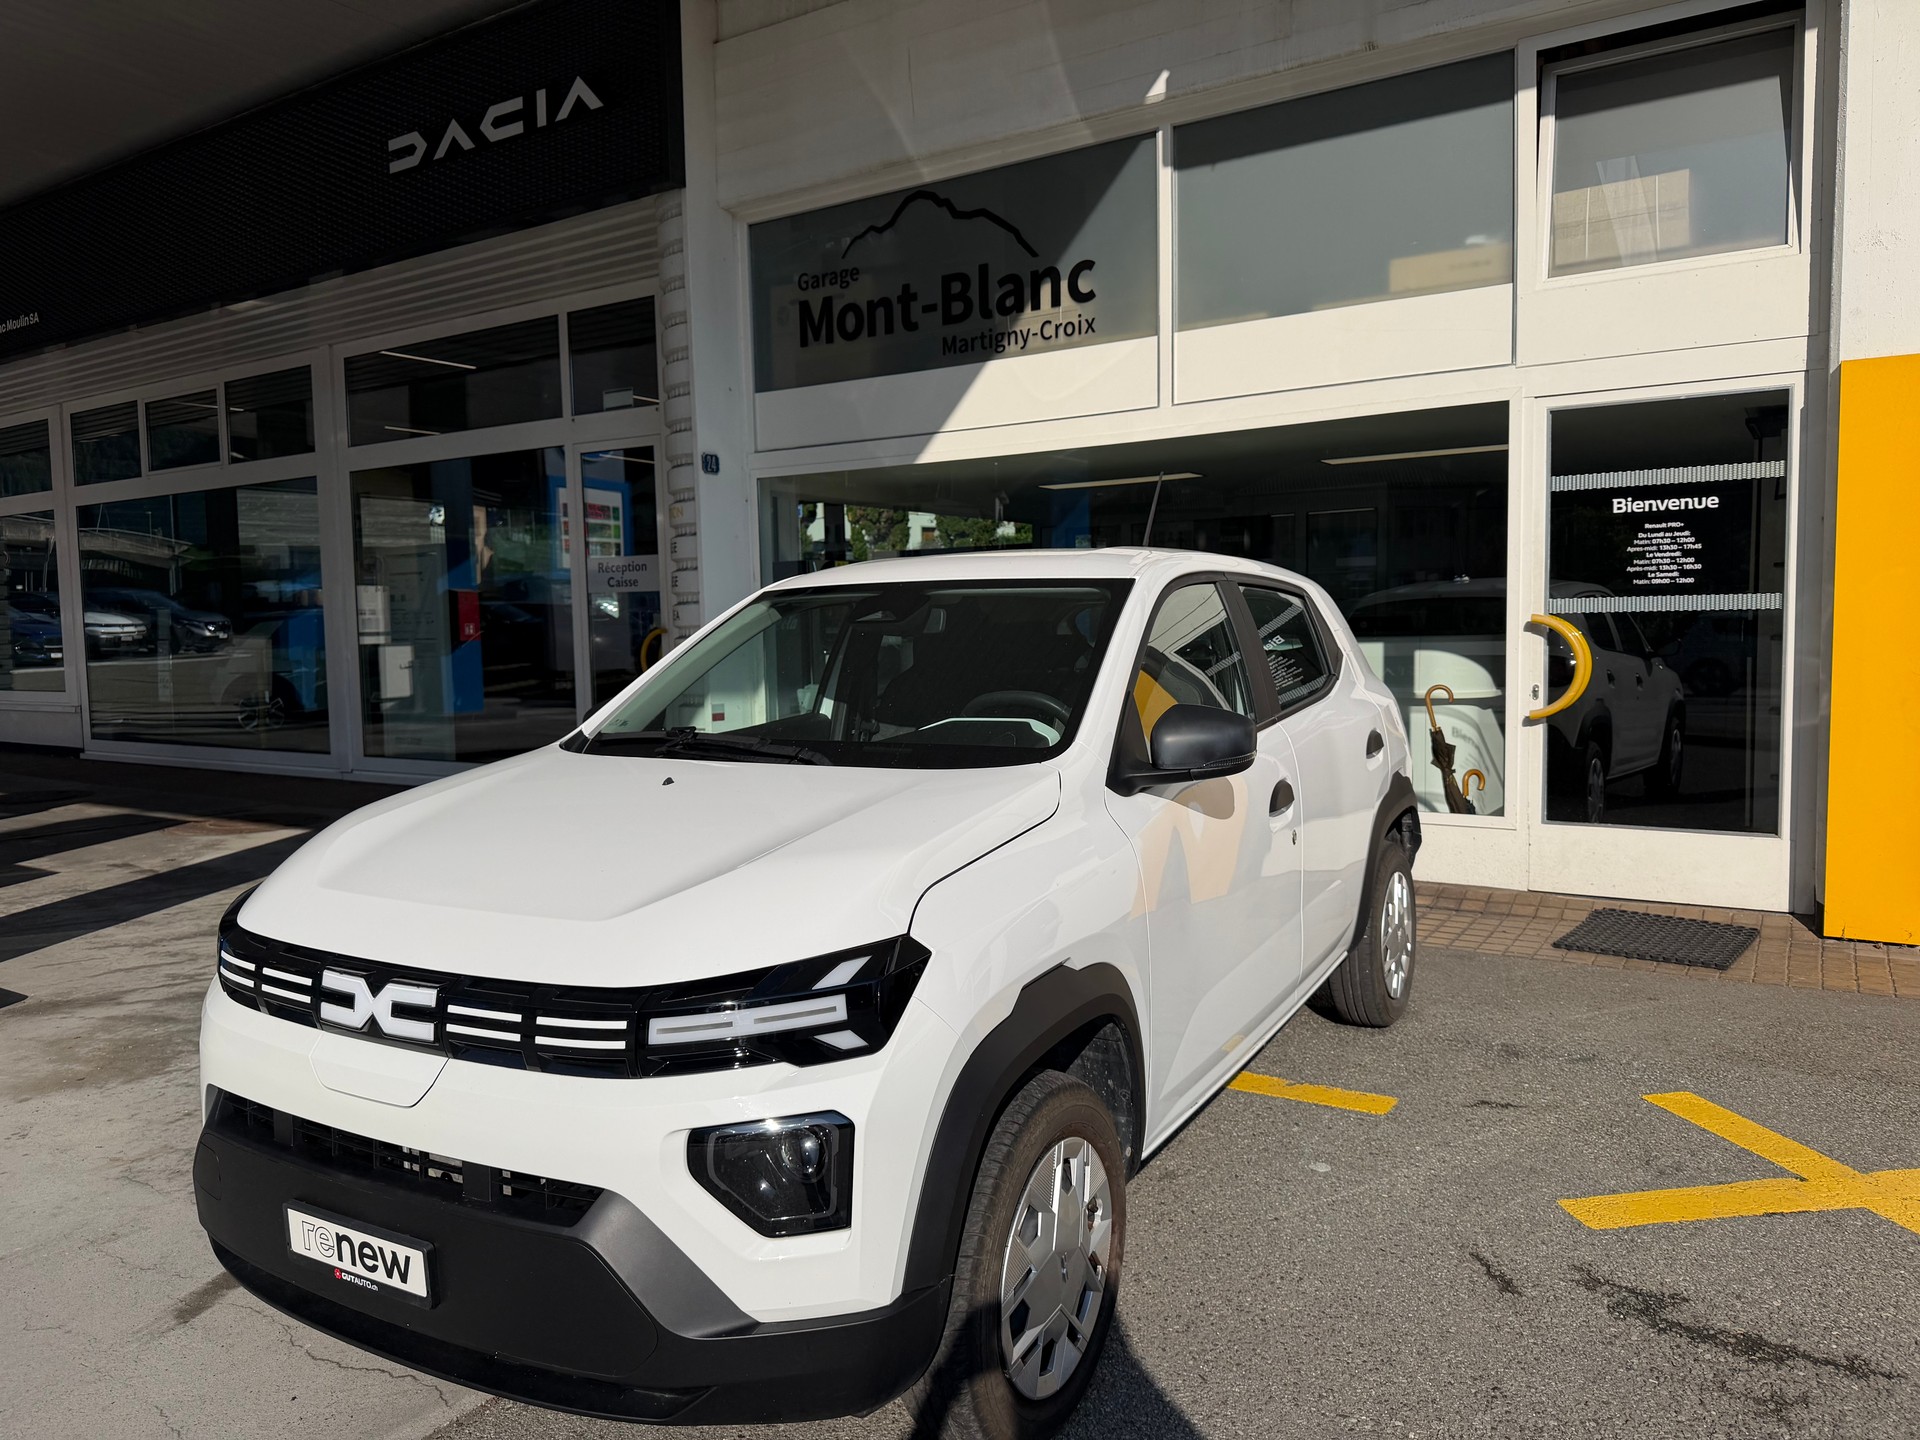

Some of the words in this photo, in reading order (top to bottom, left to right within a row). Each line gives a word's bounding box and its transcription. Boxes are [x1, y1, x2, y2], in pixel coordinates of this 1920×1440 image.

[388, 76, 604, 174] DACIA
[798, 266, 860, 291] Garage
[799, 260, 1096, 348] Mont-Blanc
[6, 314, 30, 331] Moulin
[30, 311, 40, 325] SA
[942, 314, 1096, 356] Martigny-Croix
[1612, 496, 1720, 513] Bienvenue
[598, 561, 647, 575] Réception
[607, 577, 639, 588] Caisse
[302, 1221, 411, 1284] renew
[341, 1272, 379, 1291] GUTAUTO.ch
